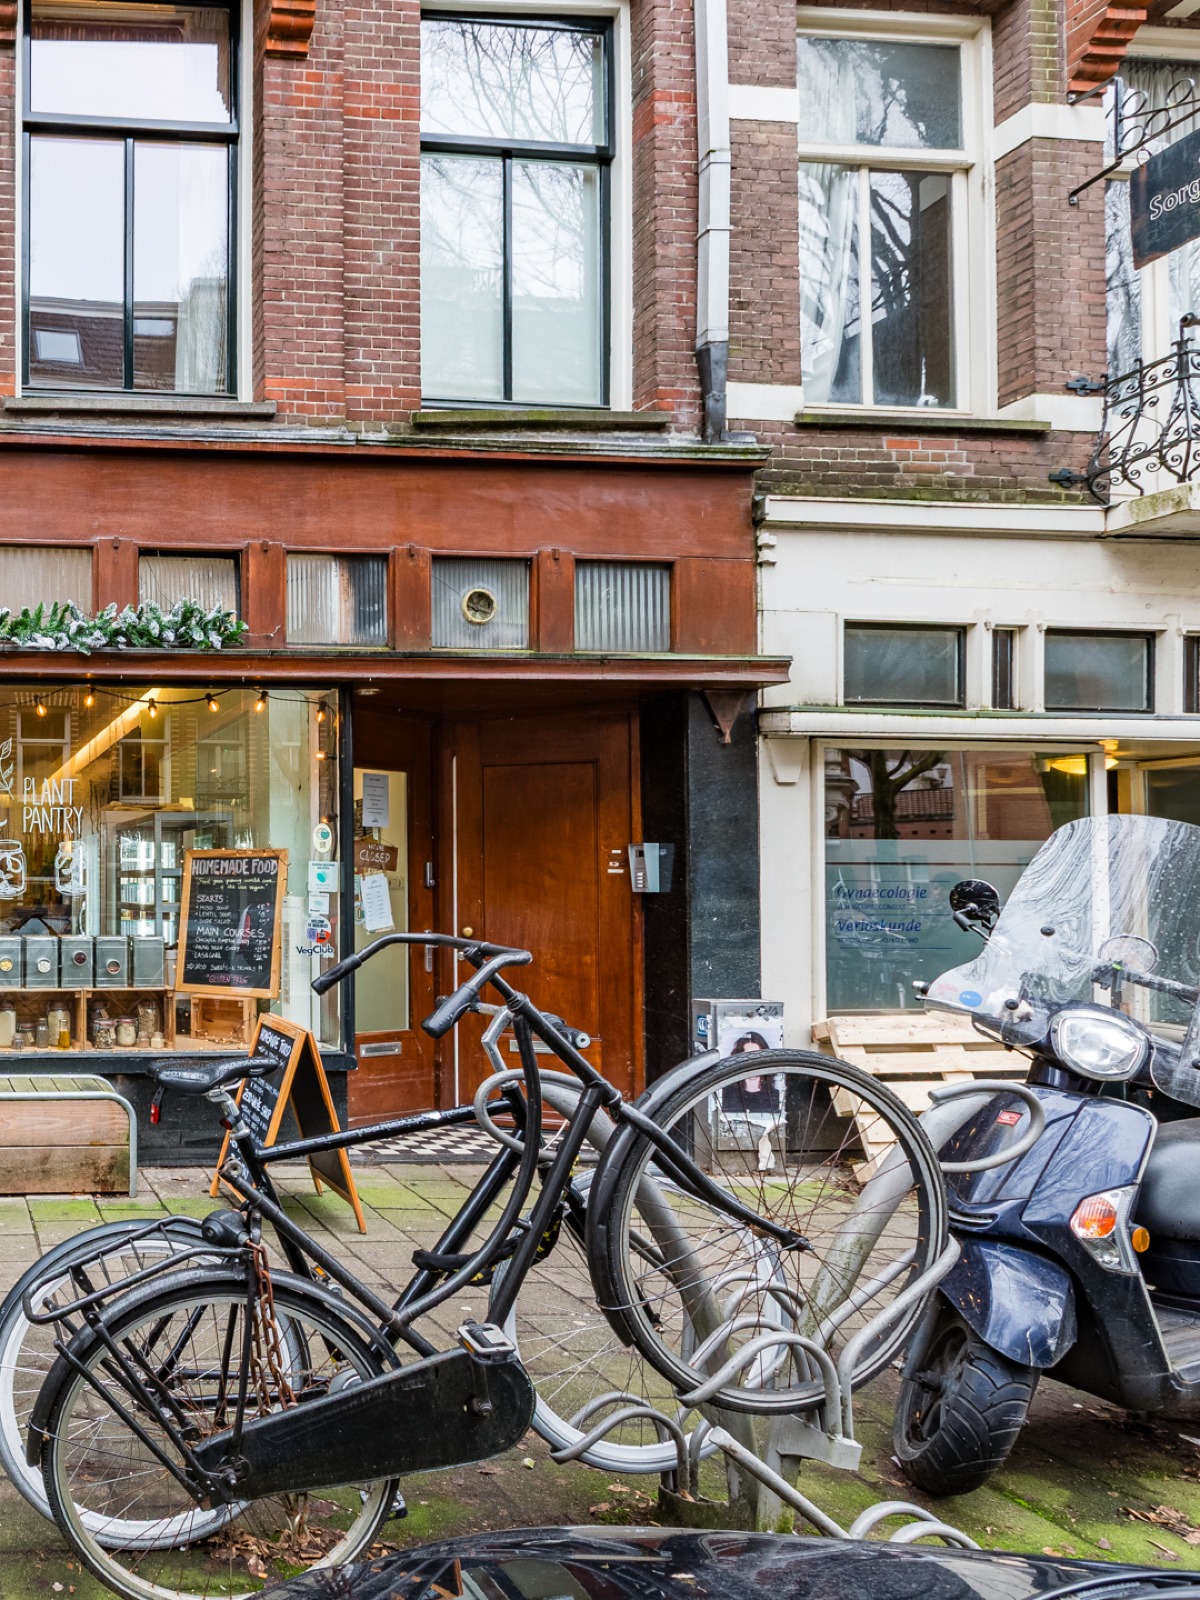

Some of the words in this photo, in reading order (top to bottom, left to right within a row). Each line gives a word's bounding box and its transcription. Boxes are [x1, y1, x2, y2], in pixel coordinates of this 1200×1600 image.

[23, 777, 79, 806] PLANT
[23, 806, 83, 834] PANTRY
[191, 859, 249, 875] HOMEMADE
[251, 859, 278, 875] FOOD
[836, 885, 928, 901] Gynaecologie
[196, 926, 219, 937] MAIN
[223, 927, 266, 939] COURSES
[296, 944, 334, 957] VegClub
